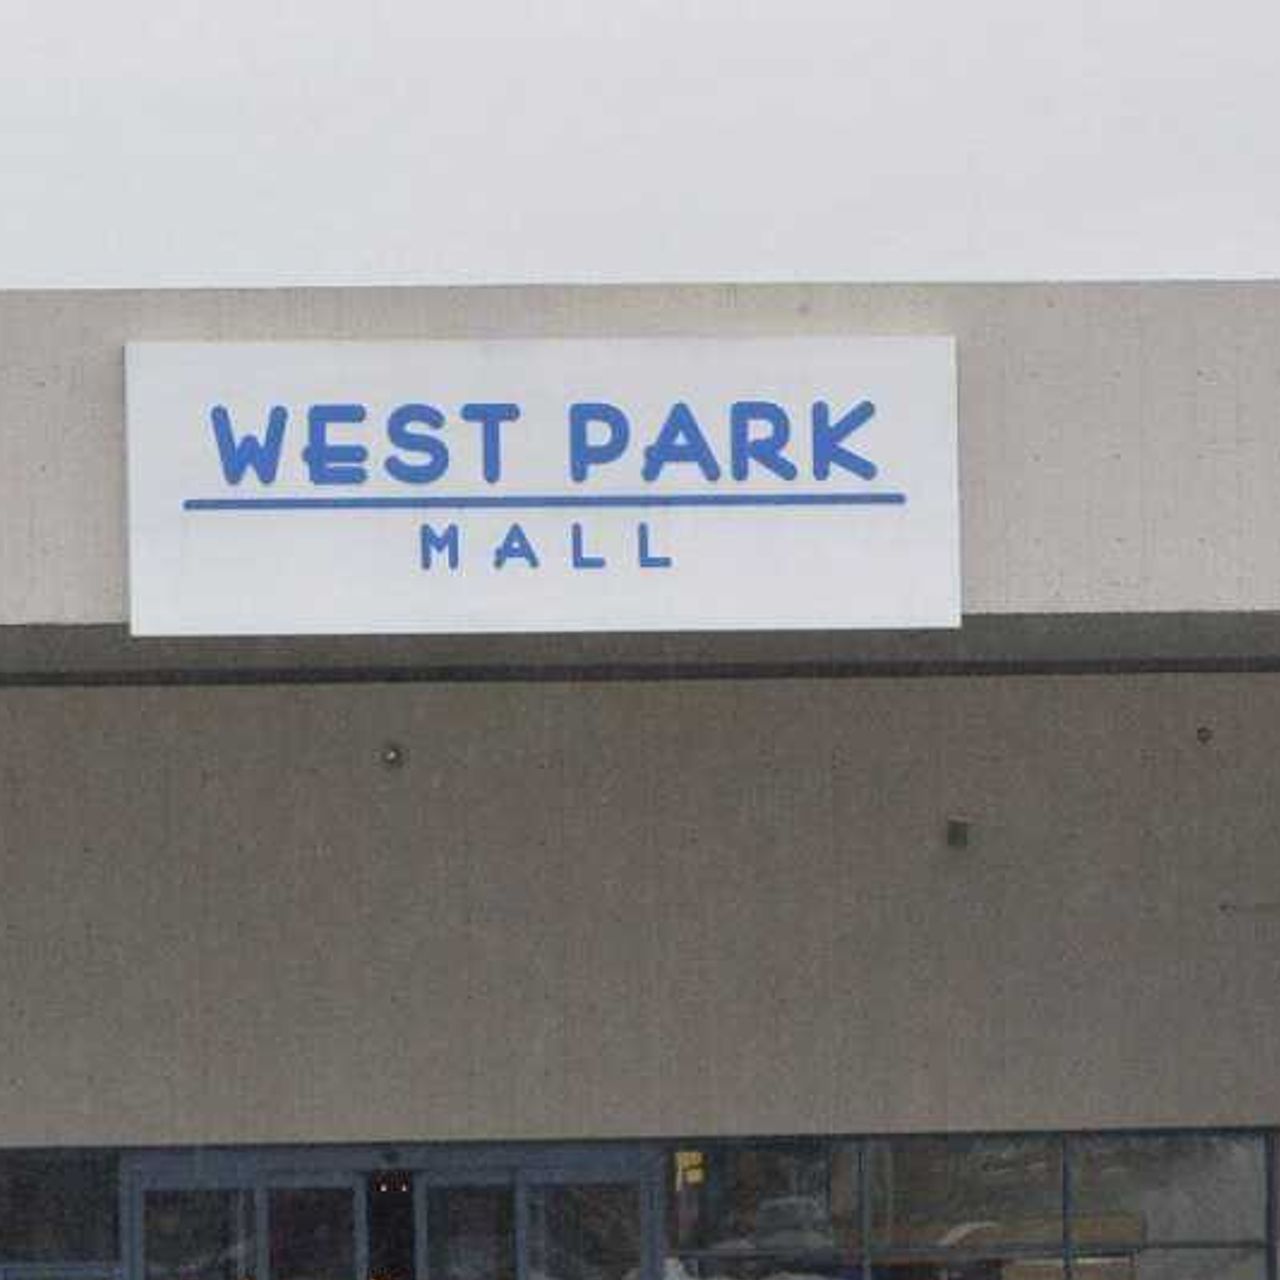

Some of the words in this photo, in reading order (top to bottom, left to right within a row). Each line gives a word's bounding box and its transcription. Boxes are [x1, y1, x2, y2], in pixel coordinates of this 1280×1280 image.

[208, 401, 523, 487] WEST
[565, 400, 876, 481] PARK
[420, 524, 669, 570] MALL
